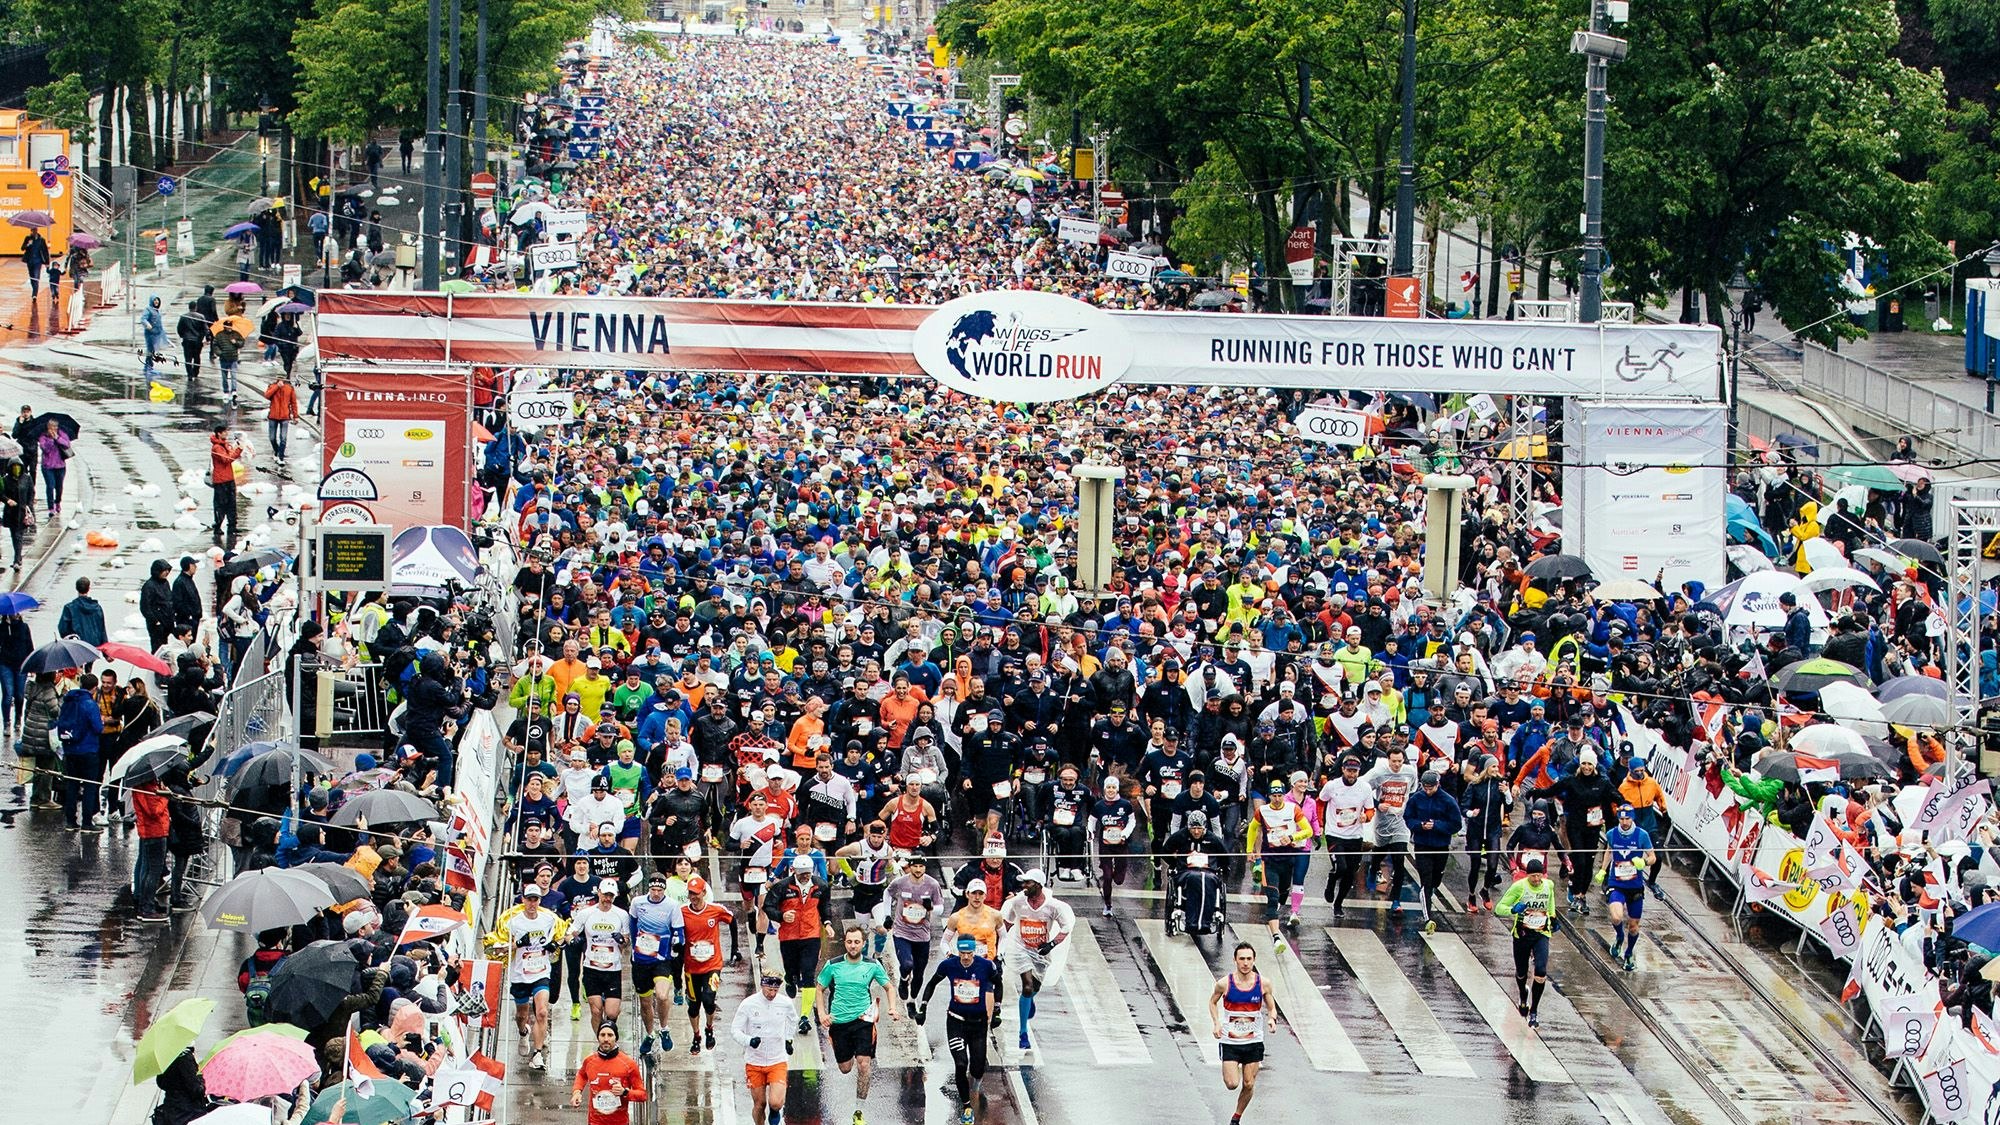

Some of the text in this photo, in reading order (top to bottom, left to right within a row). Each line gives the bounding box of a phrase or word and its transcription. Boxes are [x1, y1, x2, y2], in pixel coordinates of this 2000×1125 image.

[529, 311, 671, 354] VIENNA
[993, 328, 1051, 341] WINGS
[1002, 340, 1034, 352] LIFE
[1211, 339, 1312, 364] RUNNING
[1322, 342, 1365, 366] FOR
[1374, 344, 1443, 368] THOSE
[1452, 346, 1503, 370] WHO
[973, 351, 1101, 380] WORLD RUN
[346, 391, 447, 402] VIENNA.INFO
[332, 473, 365, 484] AUTOBUS
[325, 506, 369, 522] STRASSENBAHN
[1652, 752, 1692, 806] WORLD RUN
[593, 857, 609, 866] beat
[602, 860, 618, 870] your
[595, 867, 616, 876] limits
